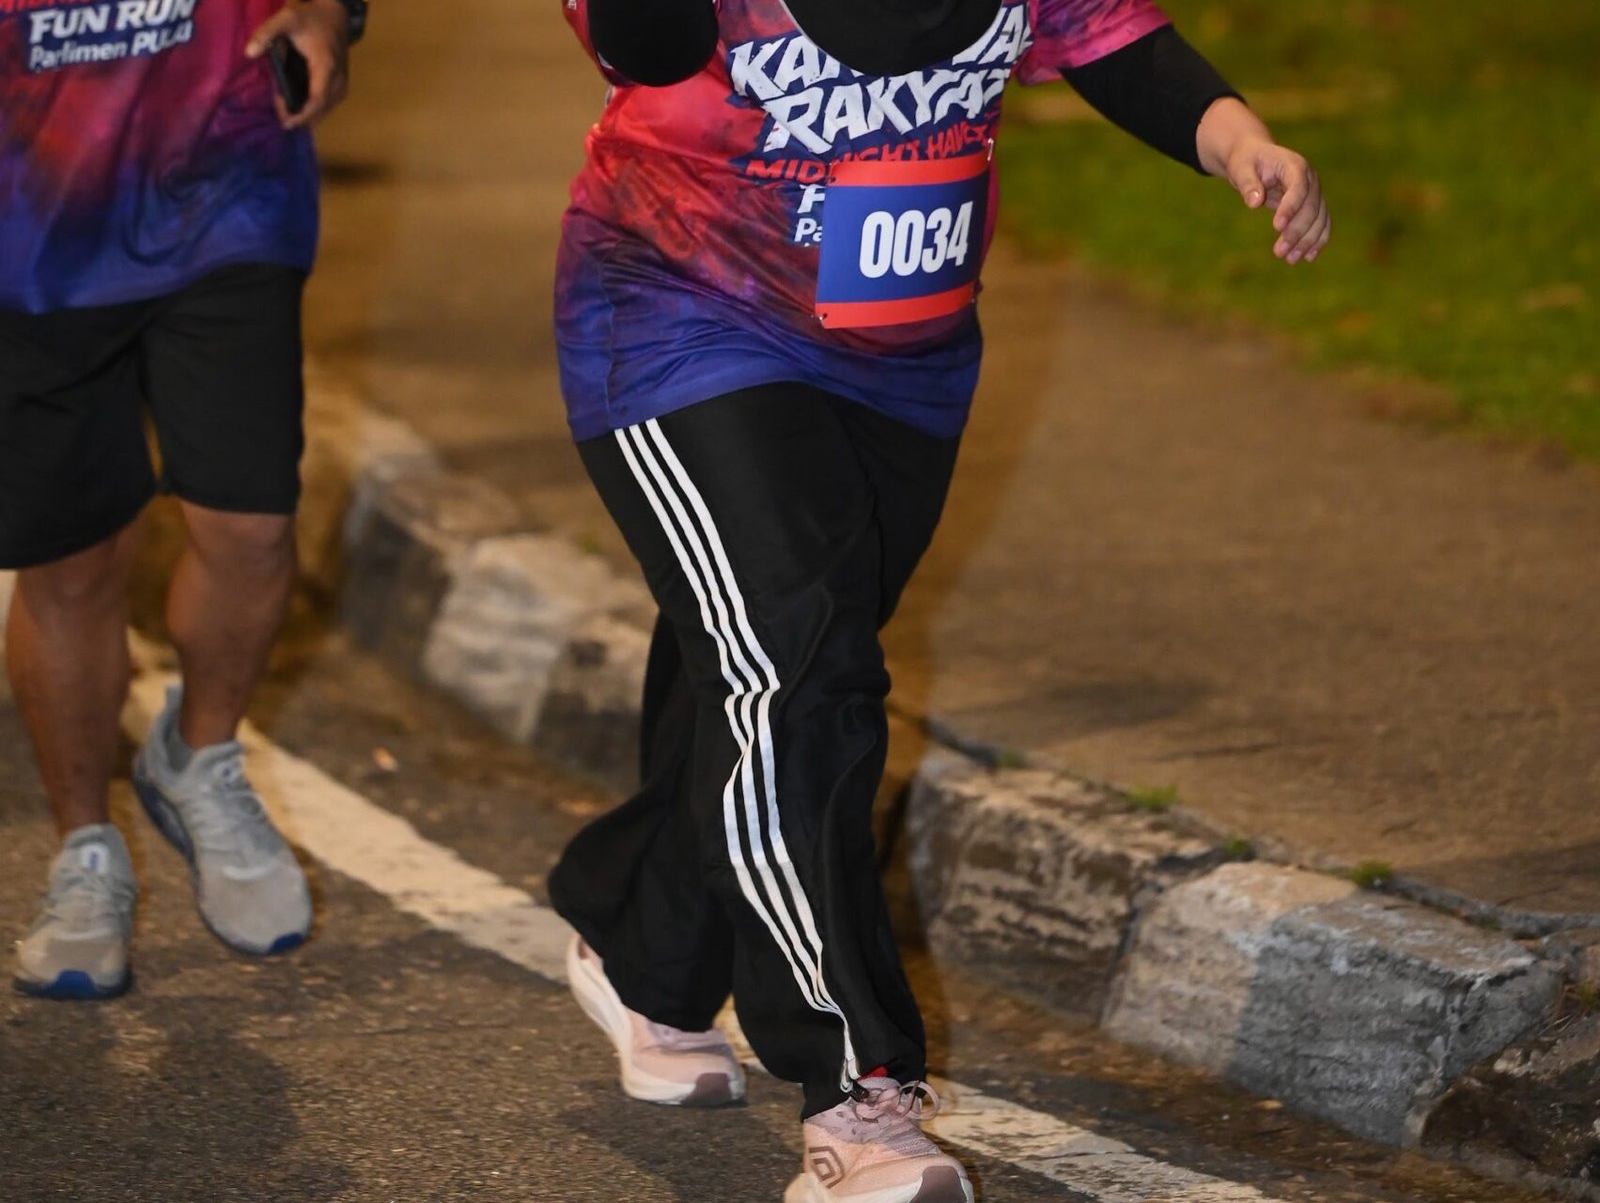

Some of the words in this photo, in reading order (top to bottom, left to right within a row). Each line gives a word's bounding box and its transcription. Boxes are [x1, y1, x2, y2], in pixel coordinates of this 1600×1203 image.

[29, 4, 111, 44] FUN
[762, 67, 1011, 154] RAKYAT
[859, 201, 974, 278] 0034
